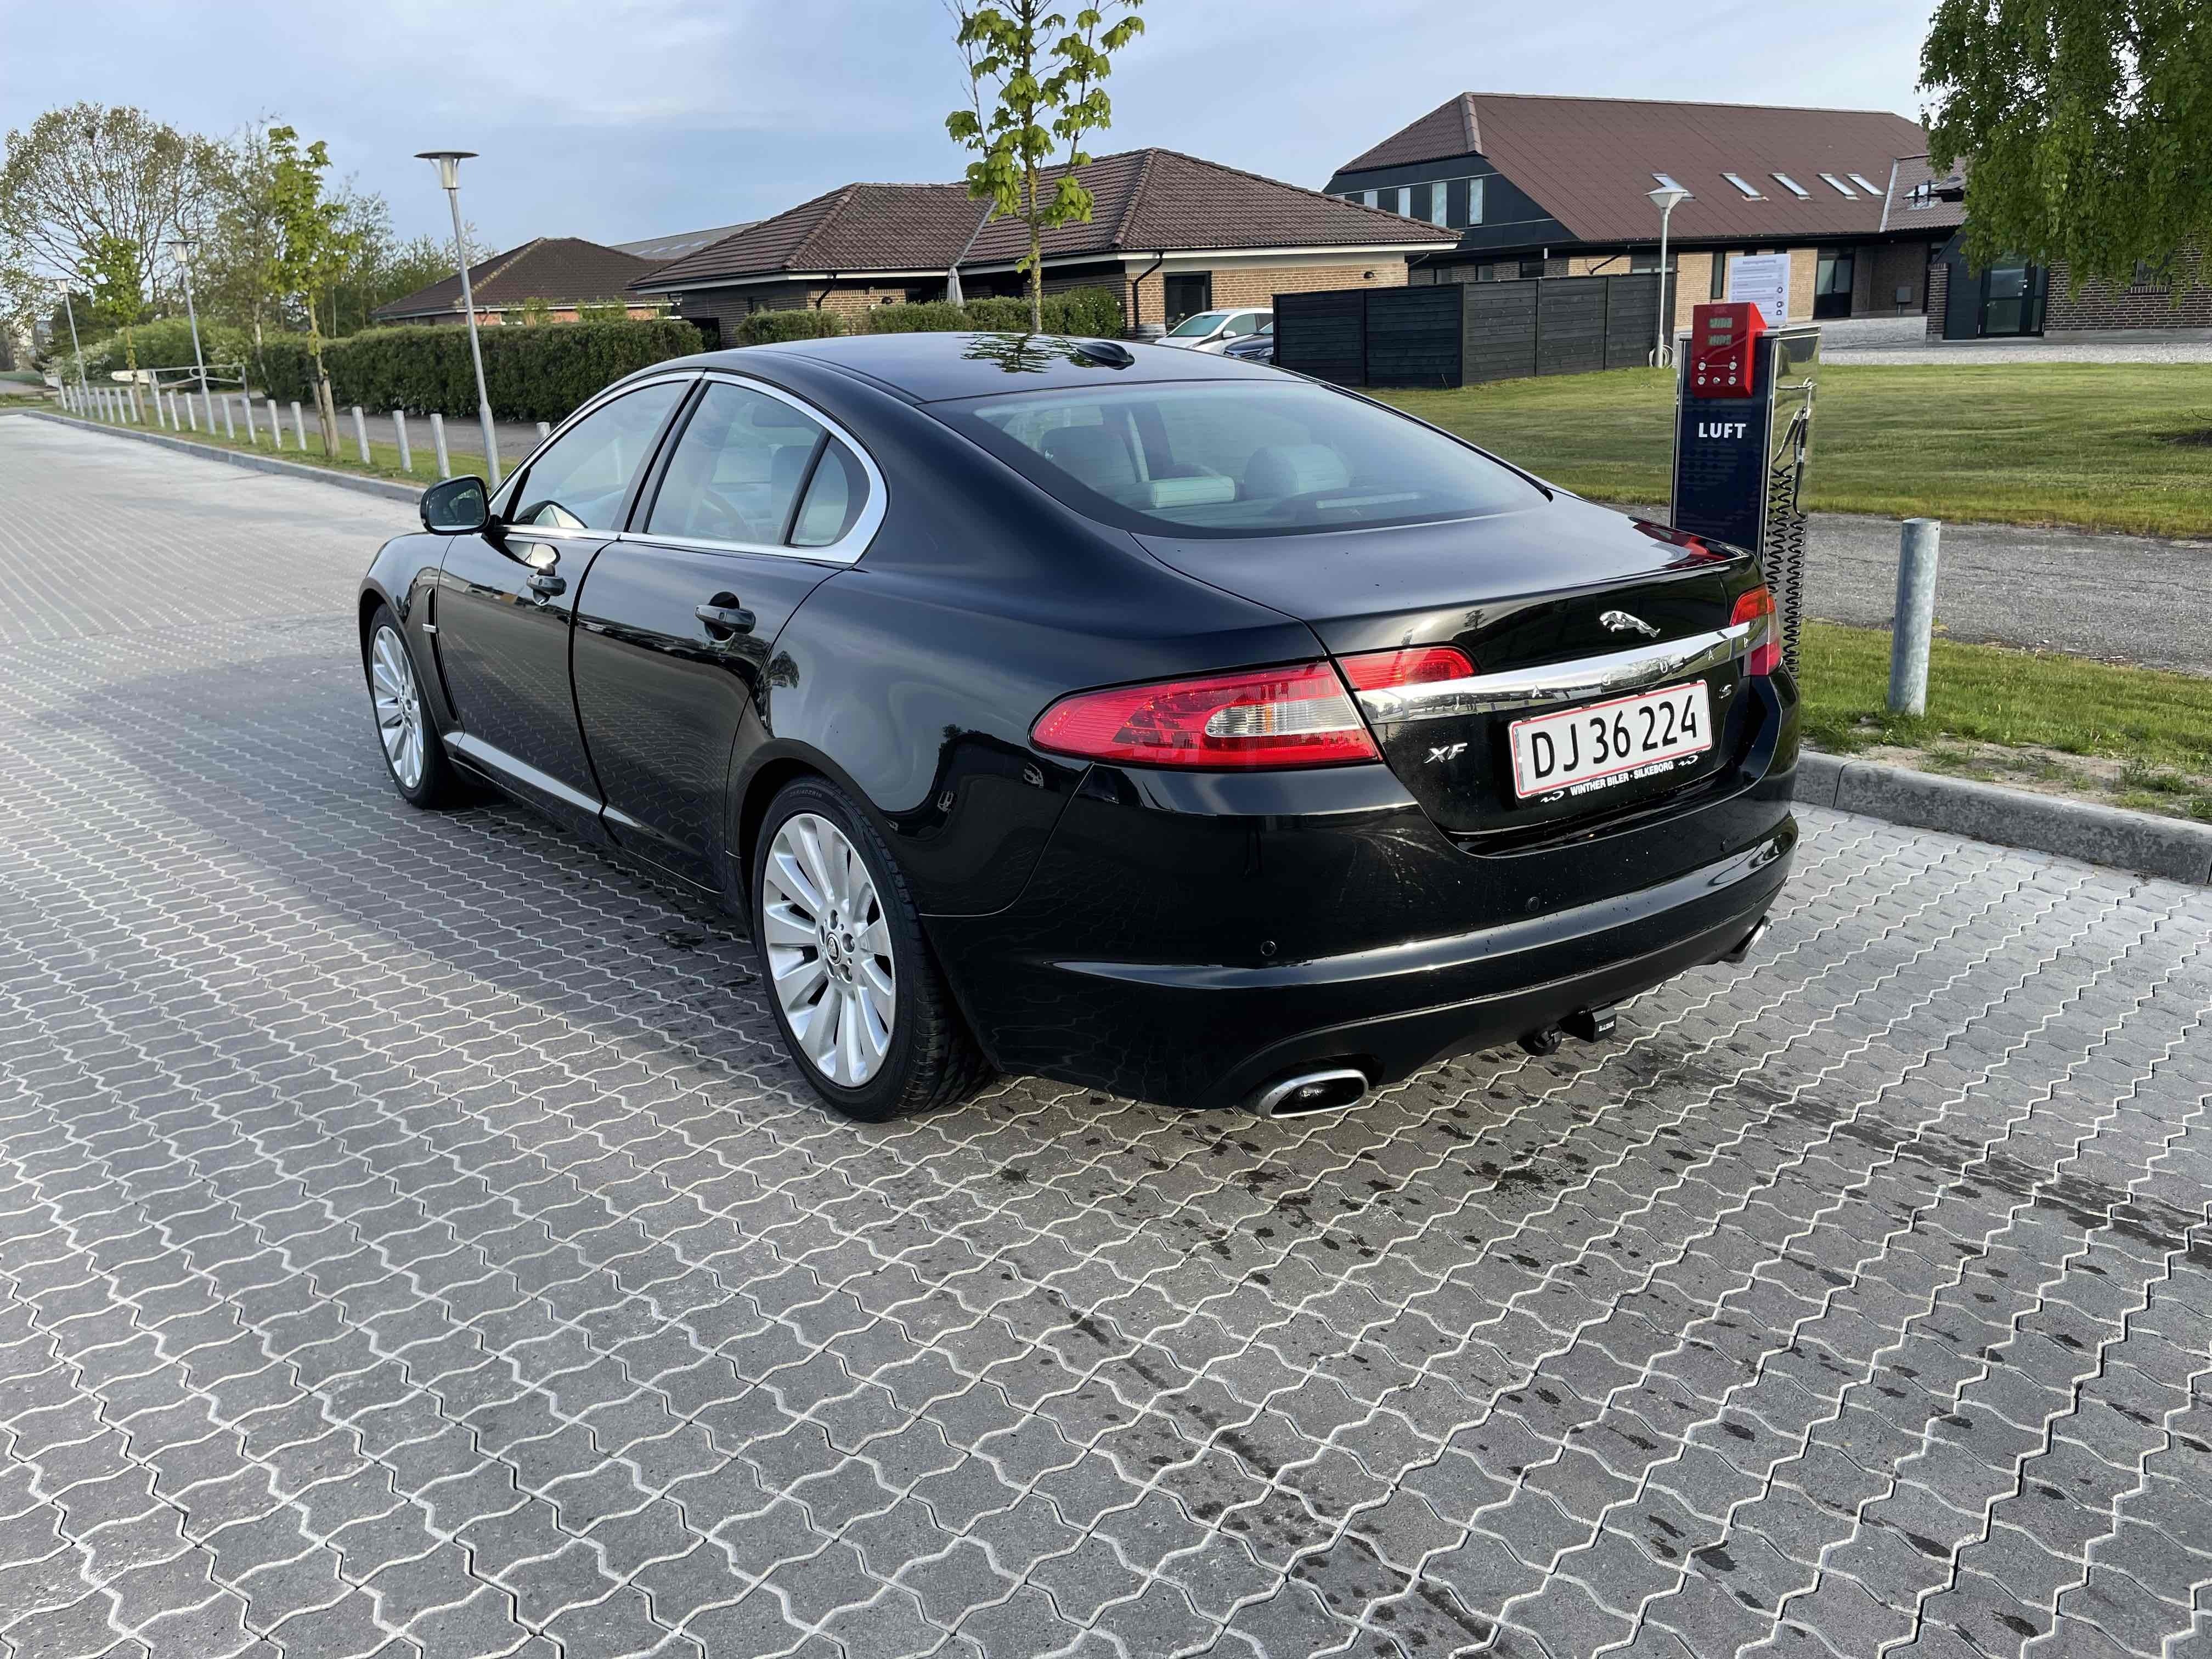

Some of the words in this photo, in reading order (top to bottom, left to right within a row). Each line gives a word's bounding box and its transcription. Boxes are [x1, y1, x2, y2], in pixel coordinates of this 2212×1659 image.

[1699, 422, 1746, 439] LUFT
[1718, 684, 1733, 699] S
[1531, 723, 1579, 779] DJ
[1590, 710, 1631, 764] 36
[1639, 695, 1697, 752] 224
[1423, 742, 1468, 764] XF
[1570, 778, 1606, 796] WINTHER
[1607, 771, 1630, 786] BILER
[1634, 760, 1674, 780] SILKEBORG
